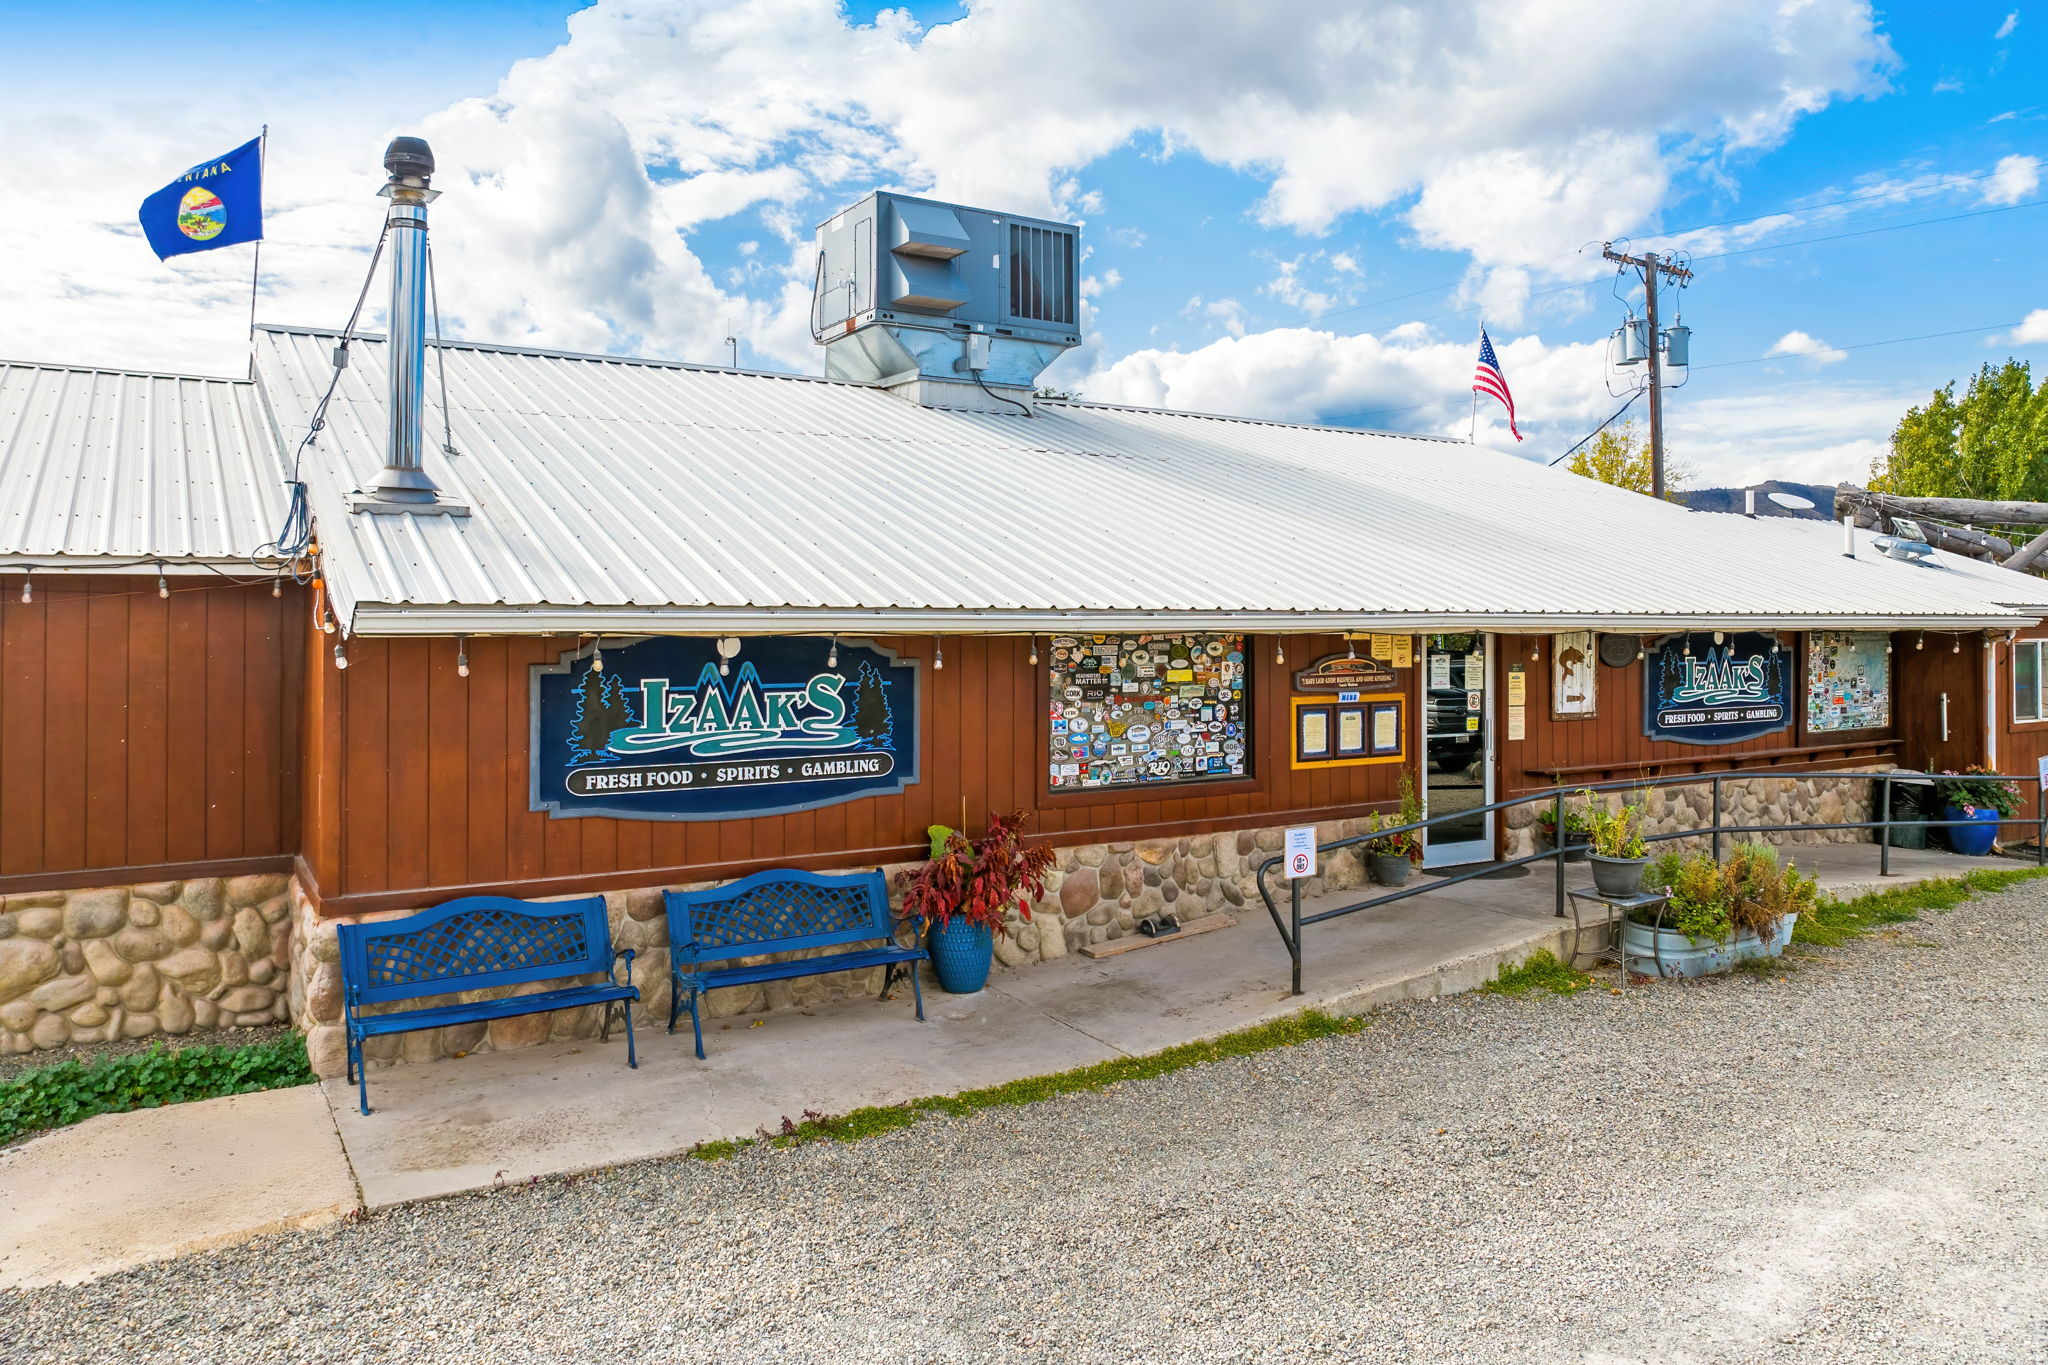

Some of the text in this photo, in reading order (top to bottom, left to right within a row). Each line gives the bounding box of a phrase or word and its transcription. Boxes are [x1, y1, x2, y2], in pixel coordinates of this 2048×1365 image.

[1664, 708, 1778, 725] FRESH FOOD SPIRITS GAMBLING
[585, 758, 881, 791] FRESH FOOD SPIRITS GAMBLING
[1148, 761, 1171, 776] RIO
